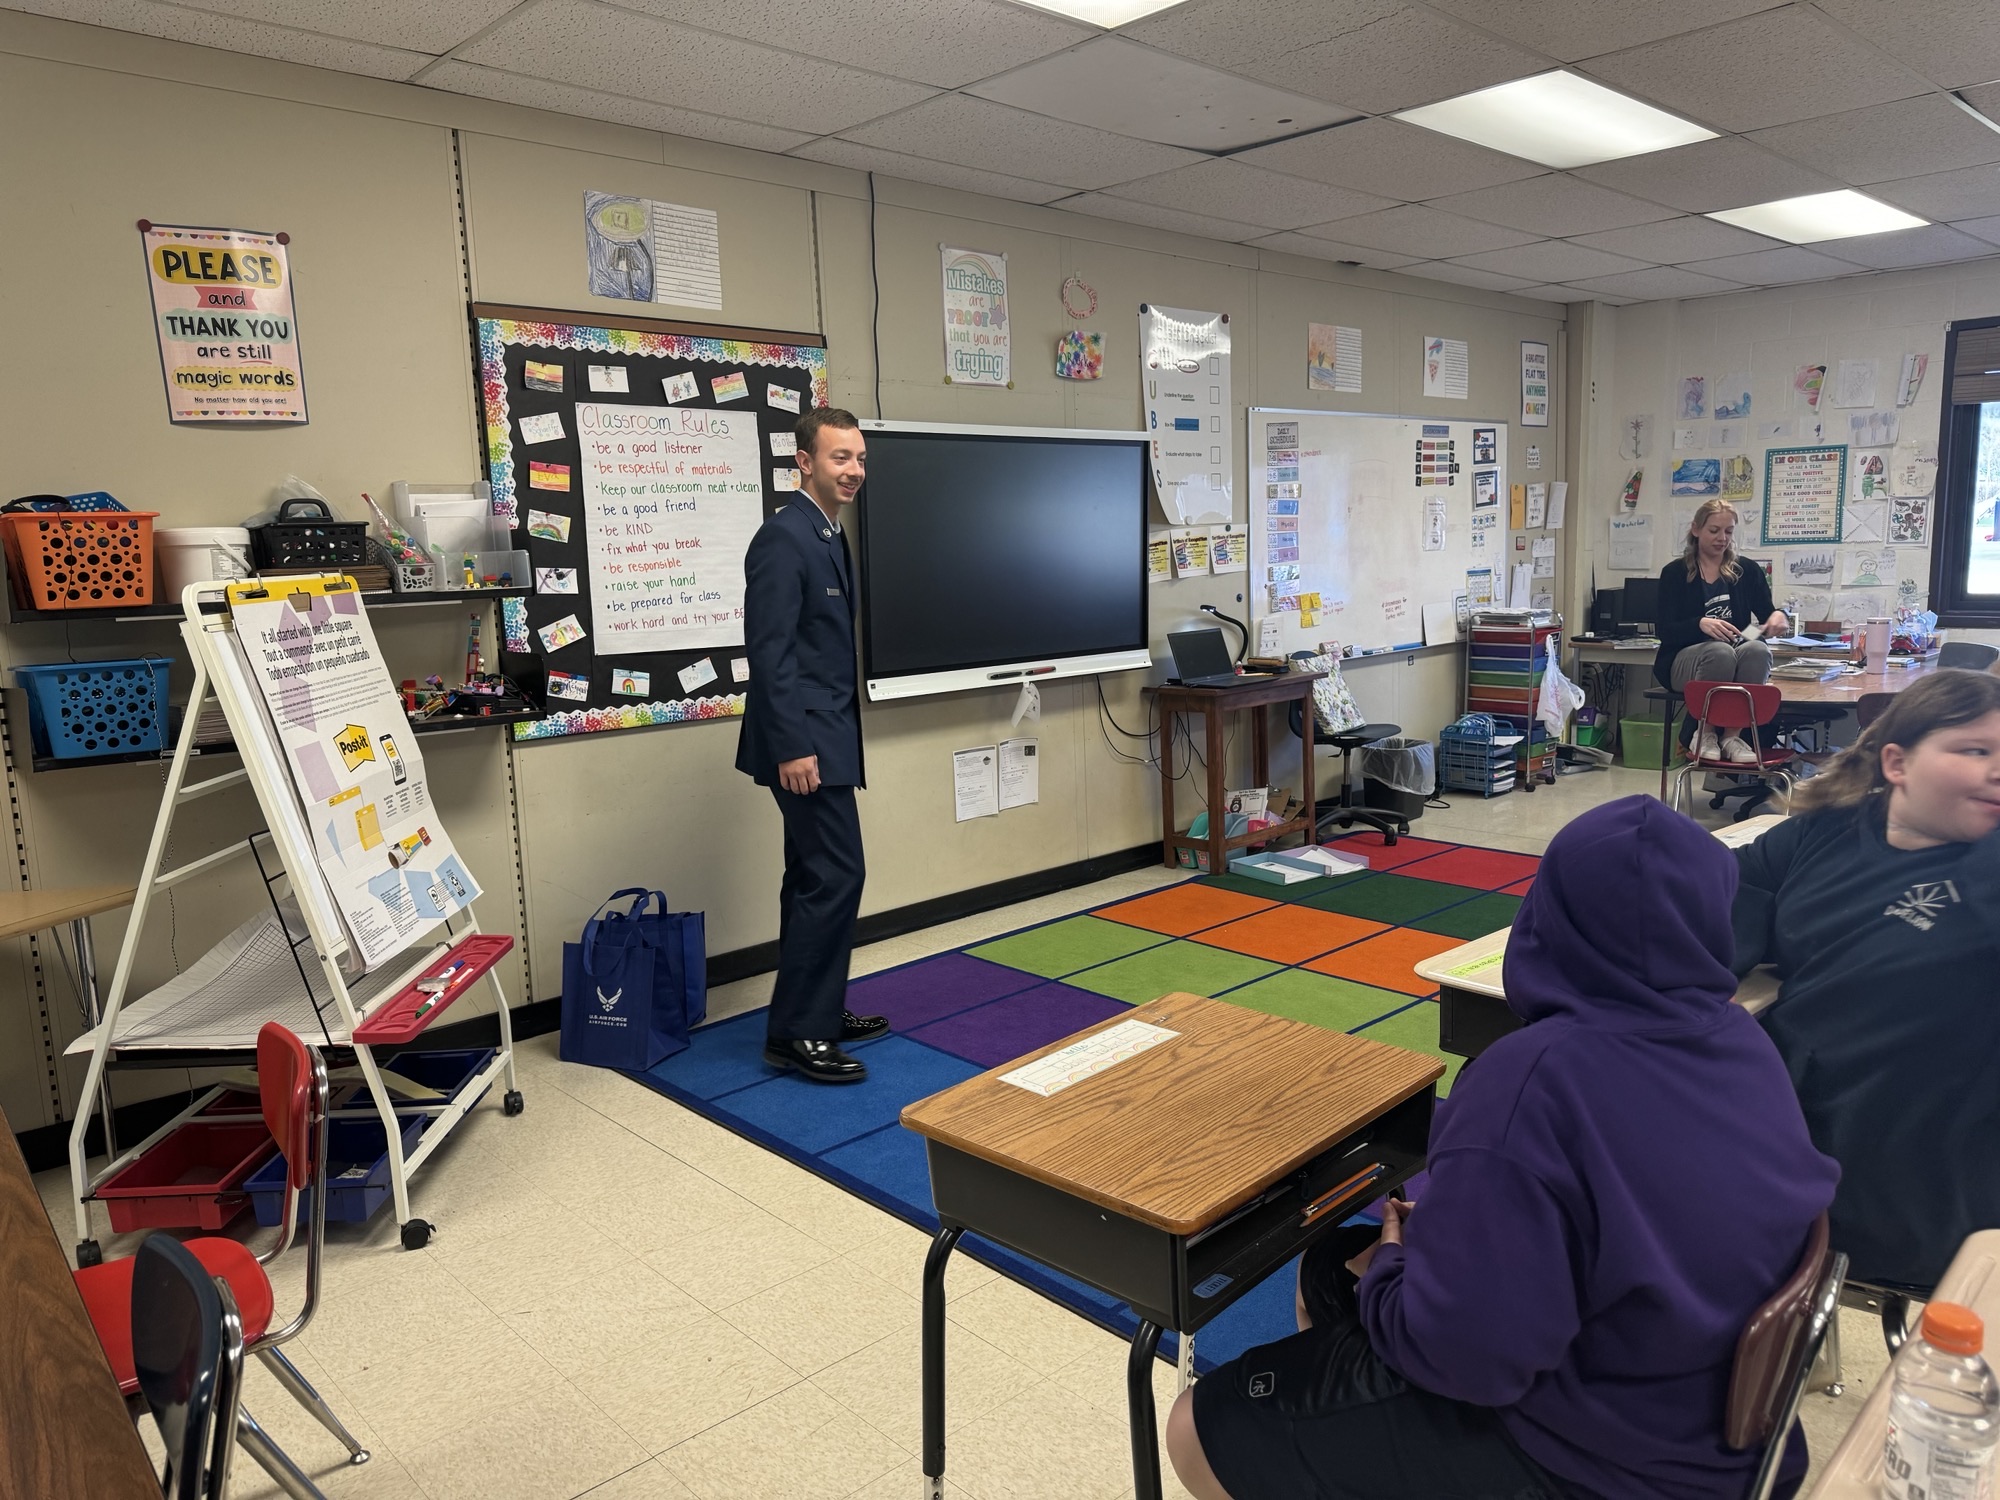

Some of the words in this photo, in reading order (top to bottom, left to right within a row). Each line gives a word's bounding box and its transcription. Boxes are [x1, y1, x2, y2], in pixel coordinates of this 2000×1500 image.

[163, 250, 276, 284] PLEASE
[946, 268, 1004, 295] Mistakes
[209, 291, 245, 306] and
[969, 295, 984, 307] are
[948, 308, 989, 327] PROOF
[166, 316, 241, 337] THANK
[246, 320, 288, 339] YOU
[950, 329, 970, 342] that
[974, 333, 990, 346] you
[993, 334, 1007, 346] are
[197, 346, 230, 358] are
[238, 344, 271, 359] still
[955, 348, 1003, 380] trying
[177, 371, 232, 388] magic
[240, 370, 294, 385] words
[1526, 369, 1535, 378] FLAT
[1537, 370, 1546, 379] TIRE
[1150, 380, 1156, 400] U
[1526, 385, 1546, 396] ANYWHERE
[582, 406, 671, 431] Classroom
[681, 410, 729, 434] Rules
[1151, 411, 1157, 429] B
[1270, 435, 1296, 444] SCHEDULE
[596, 442, 611, 455] be
[617, 445, 625, 453] a
[632, 442, 656, 457] good
[665, 441, 703, 454] listener
[1153, 441, 1159, 458] E
[1775, 456, 1786, 464] IN
[1809, 454, 1838, 462] CLASS
[599, 461, 612, 474] be
[618, 462, 669, 479] respectful
[676, 462, 684, 475] of
[692, 462, 732, 475] materials
[1157, 470, 1162, 488] S
[631, 484, 646, 495] our
[651, 481, 702, 493] classroom
[708, 482, 727, 493] neat
[736, 483, 759, 492] clean
[603, 502, 616, 515] be
[622, 506, 628, 515] a
[634, 502, 657, 519] good
[665, 497, 696, 512] friend
[605, 525, 618, 536] be
[626, 524, 653, 534] KIND
[607, 544, 622, 555] fix
[626, 541, 647, 553] what
[652, 542, 669, 555] you
[675, 538, 702, 549] break
[610, 562, 623, 574] be
[628, 558, 682, 573] responsible
[612, 580, 638, 592] raise
[643, 579, 665, 592] your
[670, 573, 696, 587] hand
[613, 601, 626, 611] be
[631, 595, 672, 612] prepared
[680, 593, 693, 604] for
[699, 591, 721, 601] class
[614, 620, 638, 631] work
[642, 616, 665, 629] hard
[672, 615, 688, 625] and
[694, 614, 707, 625] try
[712, 611, 730, 624] your
[734, 608, 744, 619] BE
[261, 630, 267, 644] It
[268, 628, 276, 643] all
[277, 626, 298, 641] started
[298, 623, 312, 638] with
[312, 624, 322, 636] one
[321, 621, 335, 634] little
[334, 619, 353, 634] square
[263, 648, 279, 662] Tout
[279, 650, 283, 659] a
[284, 640, 313, 658] commencé
[315, 640, 328, 653] avec
[328, 639, 335, 650] un
[335, 635, 348, 650] petit
[348, 632, 362, 645] carré
[266, 666, 282, 681] Todo
[282, 659, 305, 680] empezó
[306, 660, 316, 672] con
[316, 659, 324, 670] un
[324, 653, 346, 670] pequeño
[346, 648, 370, 664] cuadrado
[339, 734, 369, 756] Post-it
[1062, 1044, 1088, 1055] hello
[1884, 1442, 1911, 1480] ERO
